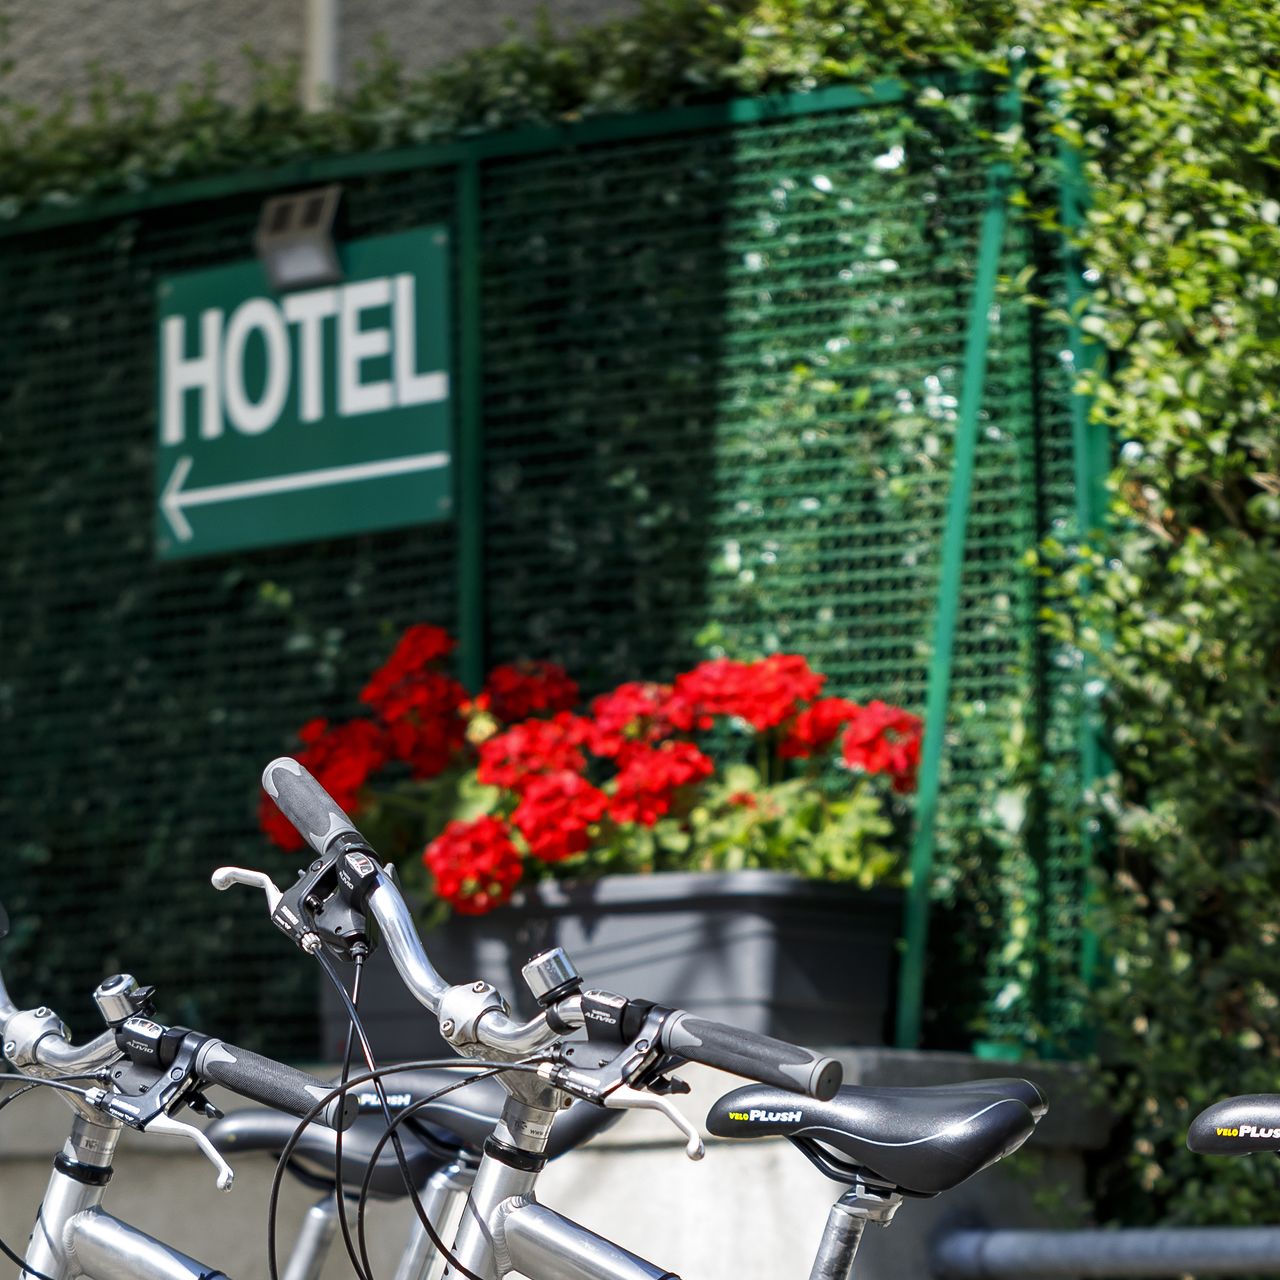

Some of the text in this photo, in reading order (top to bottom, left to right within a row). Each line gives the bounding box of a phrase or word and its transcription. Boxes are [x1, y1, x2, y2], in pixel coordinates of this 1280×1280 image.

[161, 272, 450, 446] HOTEL
[585, 1011, 617, 1025] ALIVIO
[749, 1109, 802, 1122] PLUSH
